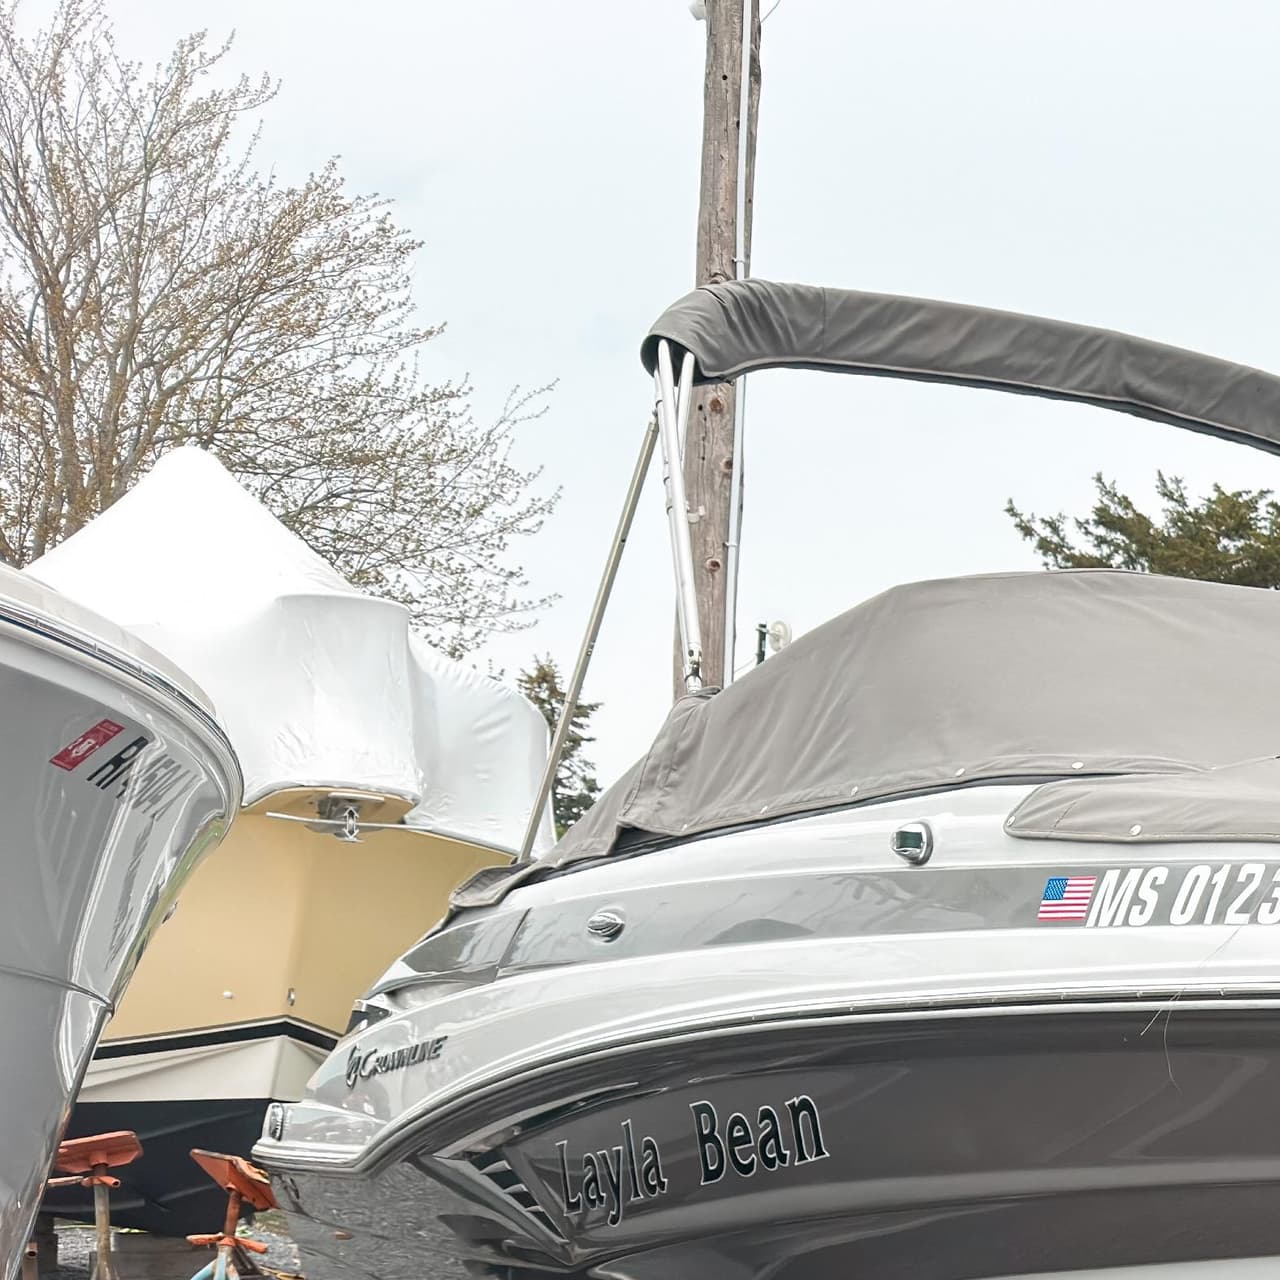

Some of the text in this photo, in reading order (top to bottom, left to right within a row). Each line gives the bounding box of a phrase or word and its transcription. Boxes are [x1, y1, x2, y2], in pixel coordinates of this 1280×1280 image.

[1085, 866, 1169, 928] MS
[555, 1094, 831, 1228] Layla Bean
